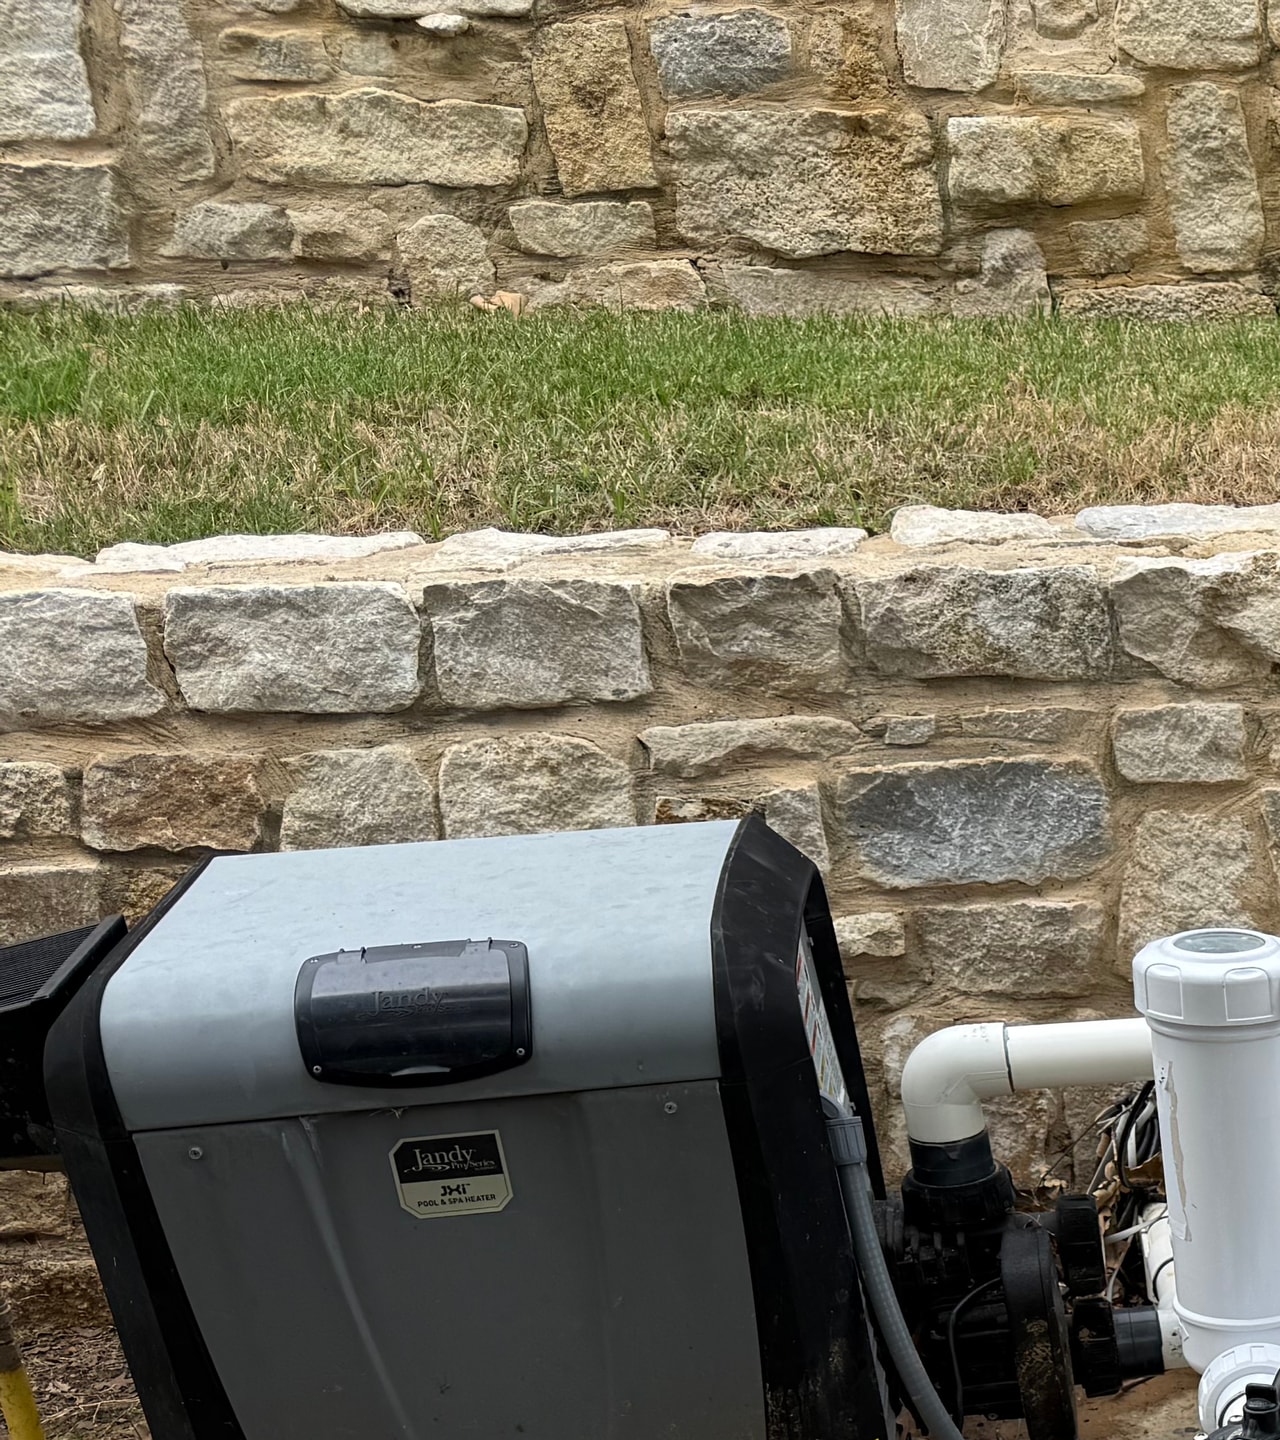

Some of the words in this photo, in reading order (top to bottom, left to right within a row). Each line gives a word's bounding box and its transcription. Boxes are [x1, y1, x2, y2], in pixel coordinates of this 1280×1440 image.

[411, 1145, 474, 1172] Jandy
[417, 1200, 440, 1208] POOL
[448, 1197, 464, 1205] SPA
[465, 1194, 496, 1204] HEATER
